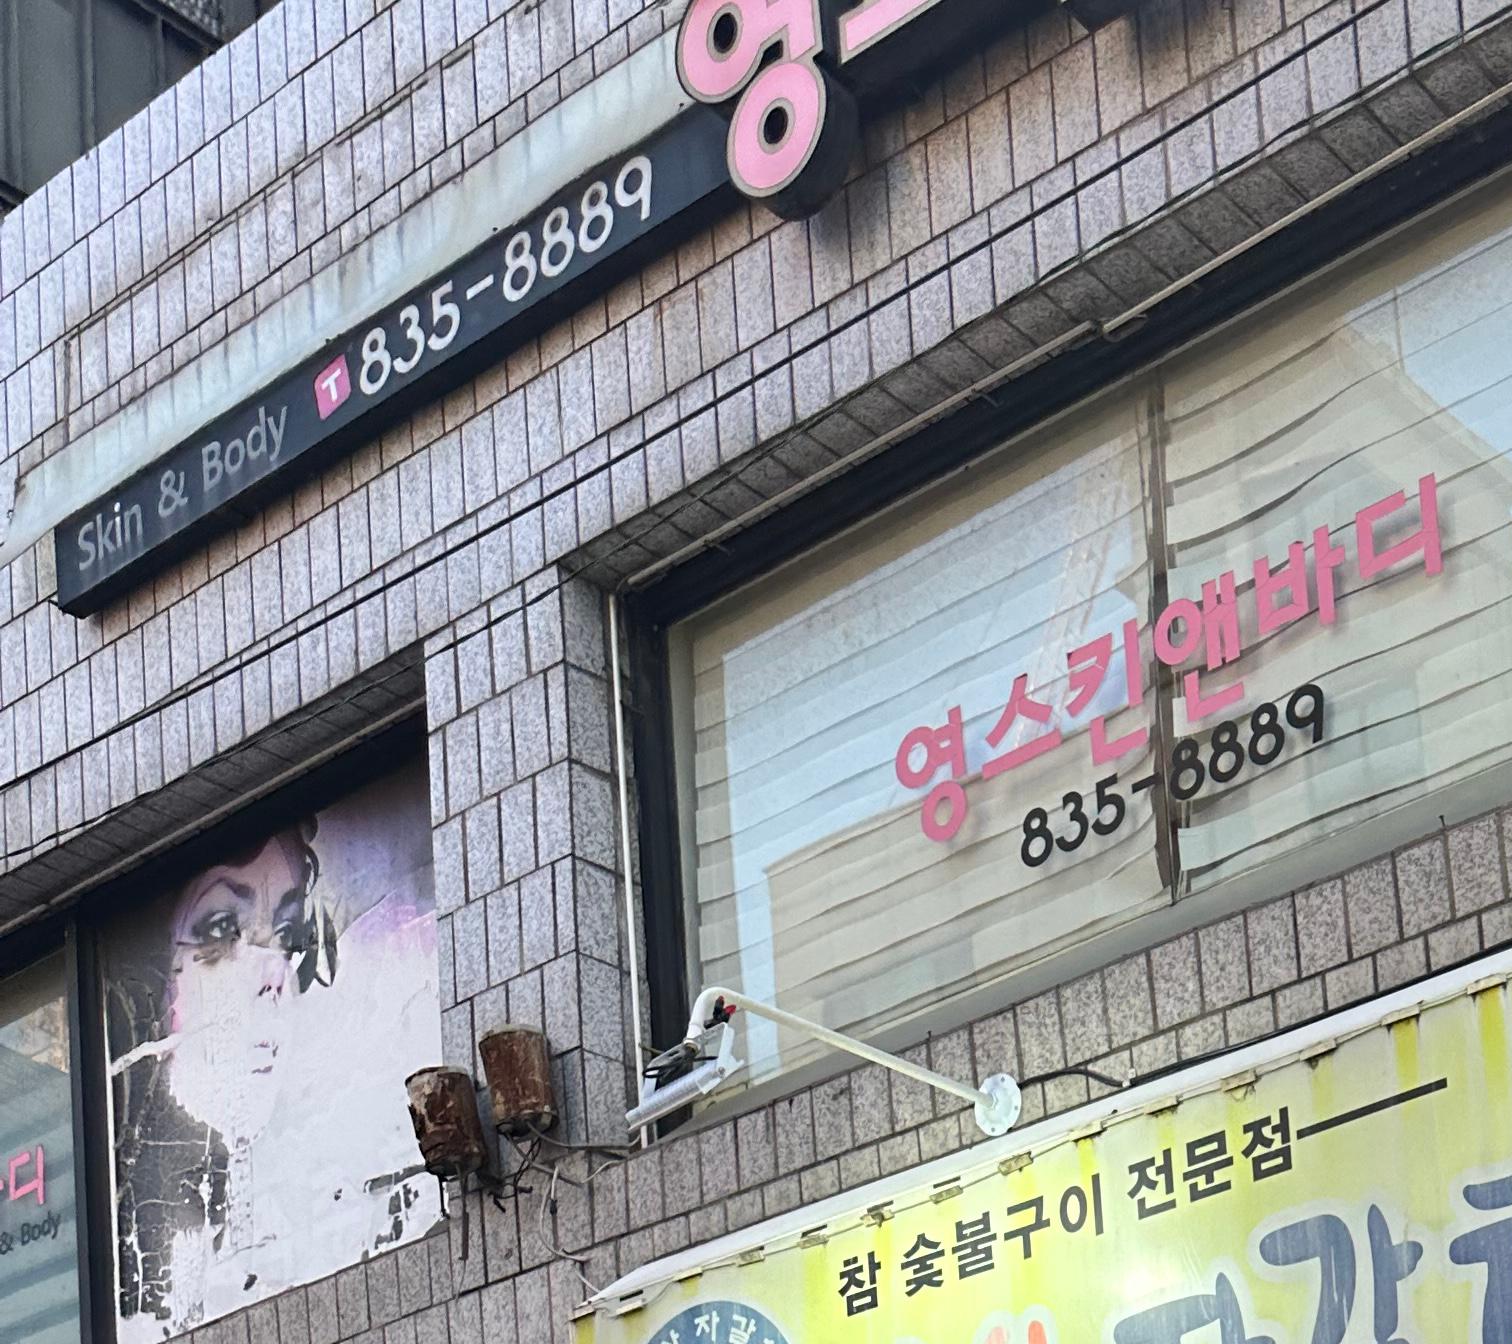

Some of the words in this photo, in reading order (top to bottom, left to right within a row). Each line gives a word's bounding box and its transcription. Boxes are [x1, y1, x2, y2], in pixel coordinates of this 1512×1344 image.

[359, 154, 653, 396] 835-8889
[77, 501, 144, 571] Skin
[158, 468, 188, 518] &
[201, 405, 288, 491] Body
[894, 472, 1444, 843] 영스킨앤바디
[1020, 683, 1325, 868] 835-8889
[0, 1144, 46, 1206] 디
[20, 1211, 61, 1247] Body
[838, 1250, 882, 1317] 참
[900, 1172, 1104, 1299] 숯불구이
[1127, 1106, 1293, 1221] 전문점
